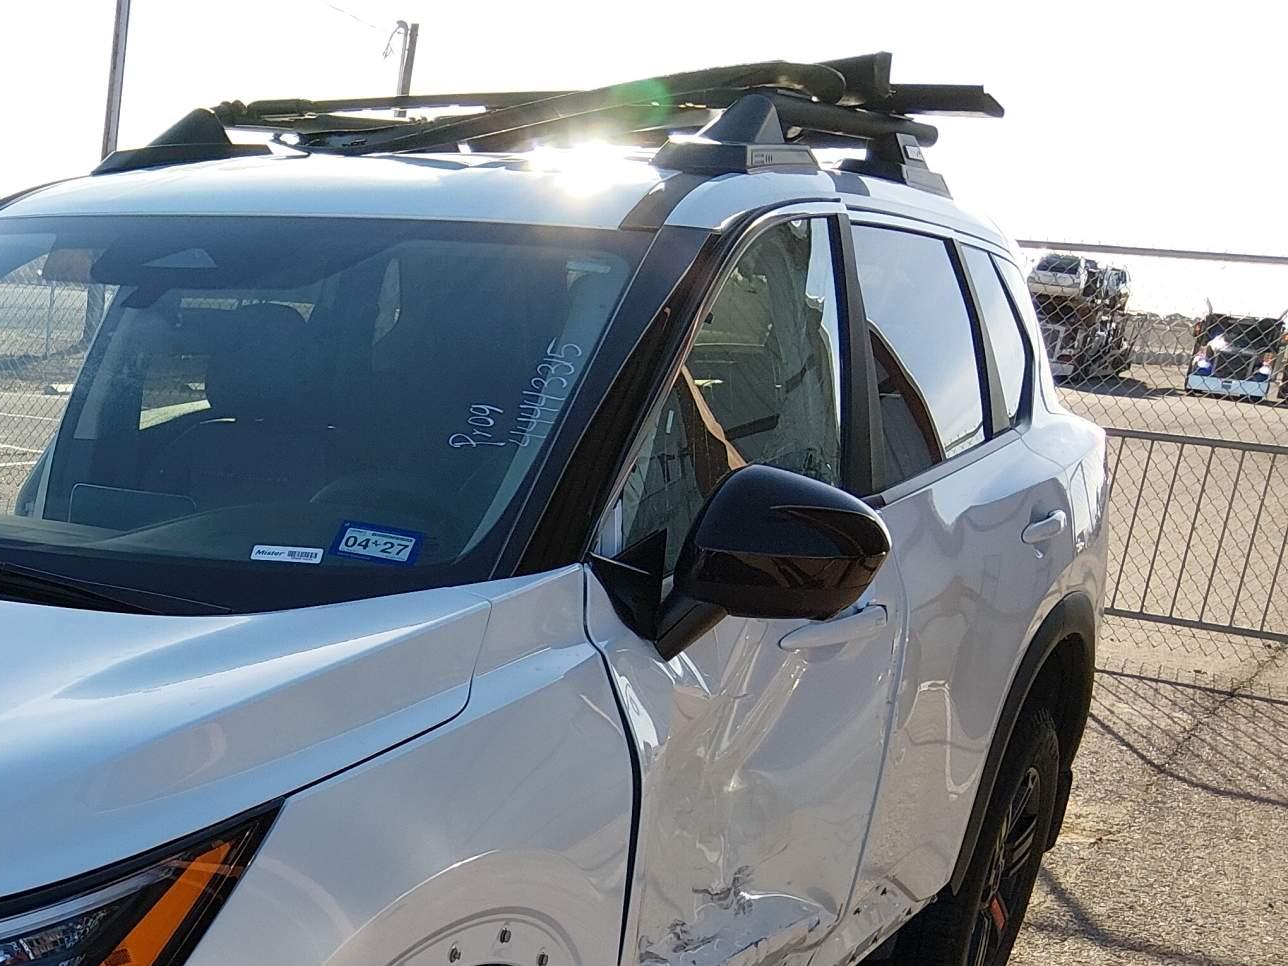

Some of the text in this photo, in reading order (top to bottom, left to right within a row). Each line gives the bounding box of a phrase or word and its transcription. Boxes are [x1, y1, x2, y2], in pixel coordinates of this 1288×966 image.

[508, 337, 582, 447] 44443315
[344, 535, 370, 550] 04
[379, 541, 410, 556] 27
